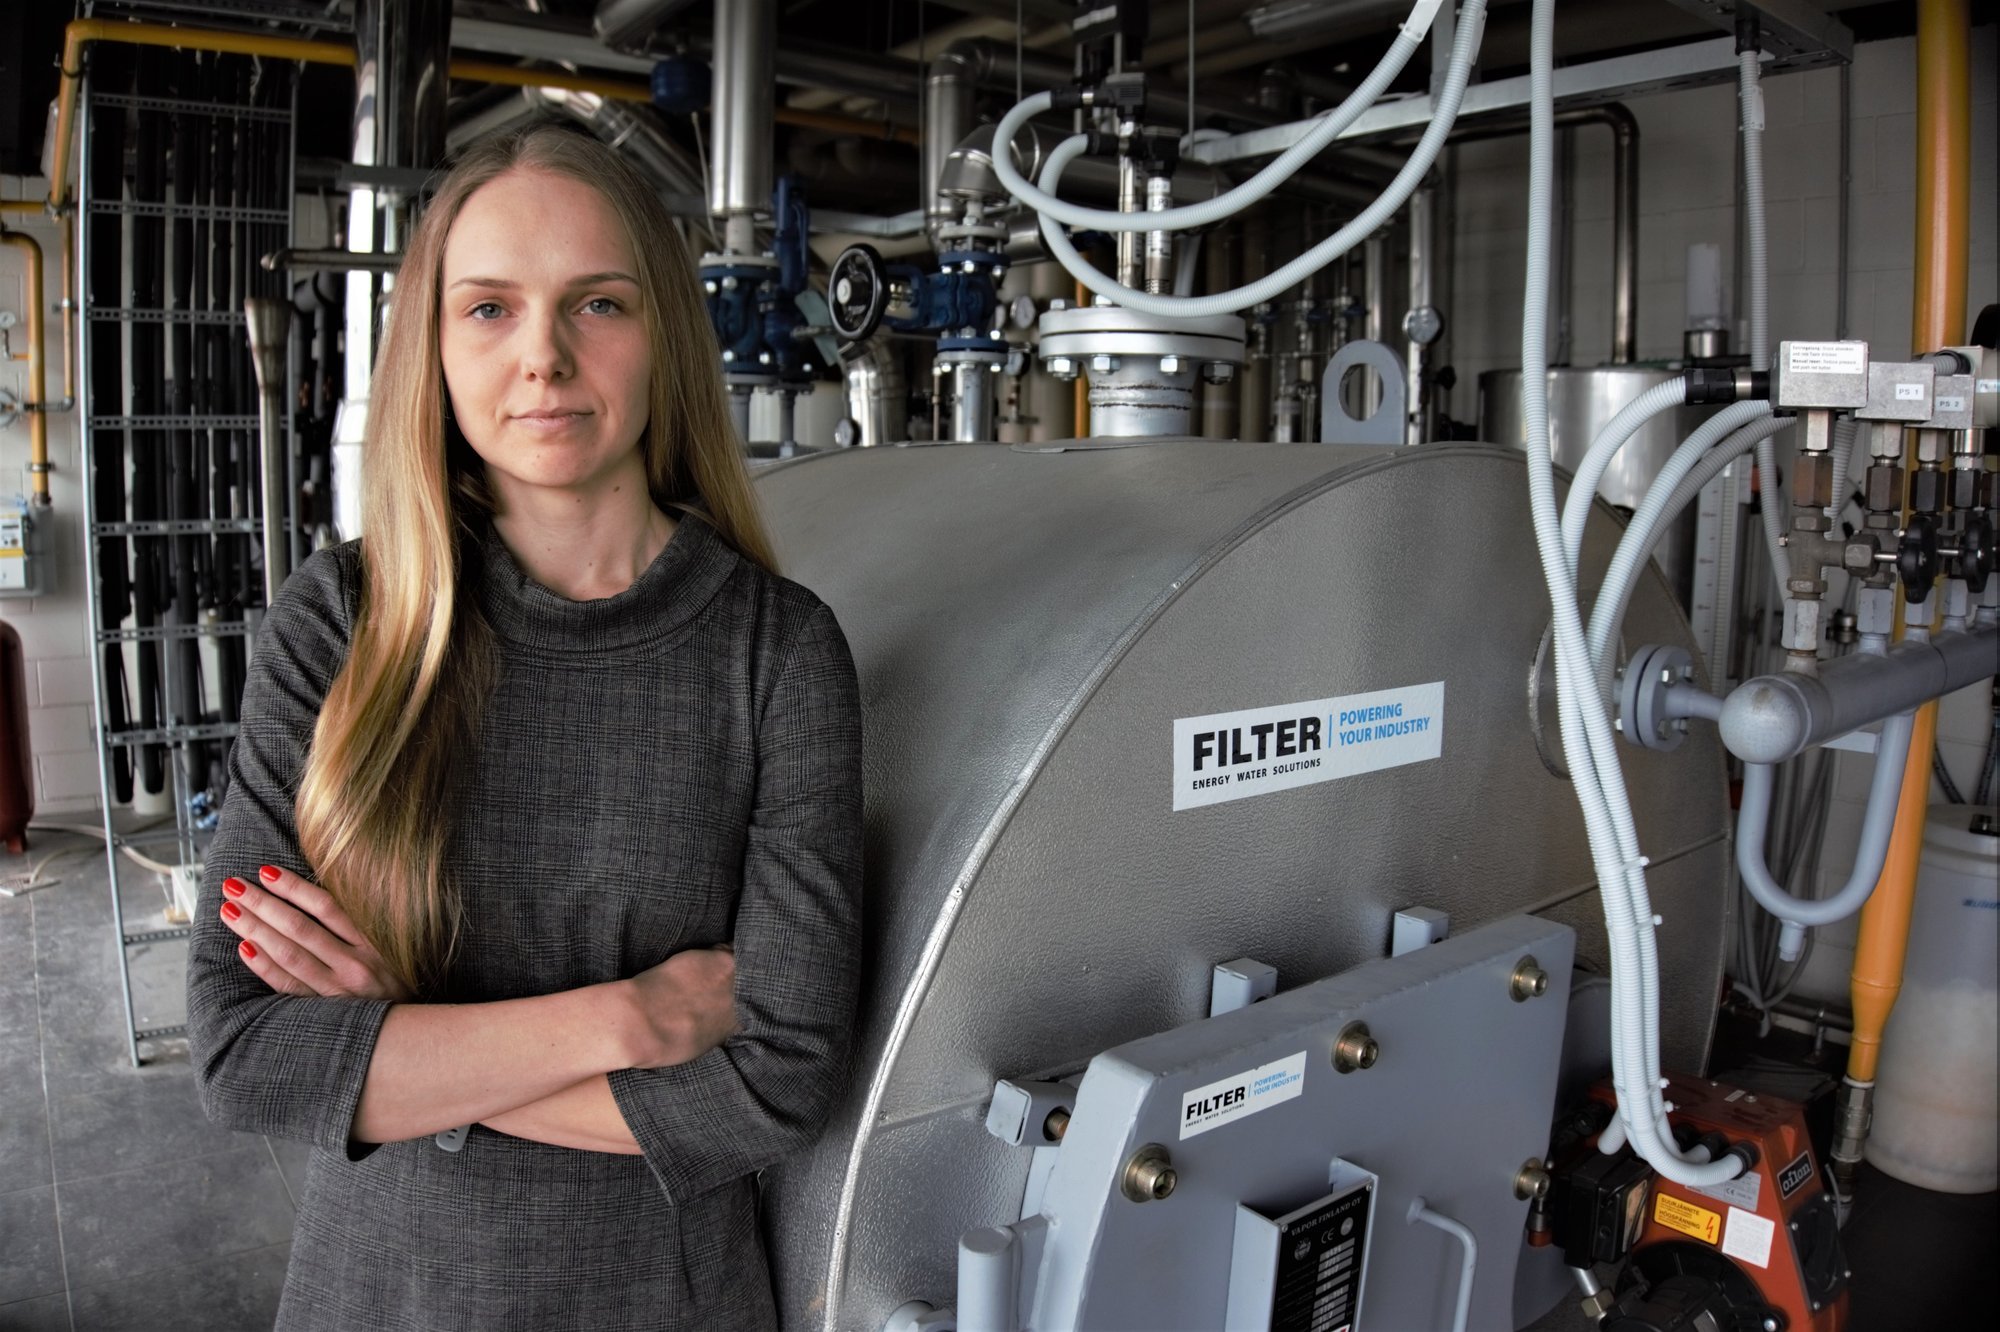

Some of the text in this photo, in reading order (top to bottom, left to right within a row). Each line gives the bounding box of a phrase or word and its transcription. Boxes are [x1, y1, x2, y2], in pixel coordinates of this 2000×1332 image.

[1339, 703, 1402, 726] POWERING
[1193, 716, 1321, 771] FILTER
[1339, 717, 1430, 746] YOUR INDUSTRY
[1192, 758, 1321, 790] ENERGY WATER SOLUTIONS
[1253, 1073, 1301, 1096] YOUR INDUSTRY
[1254, 1071, 1287, 1087] POWERING
[1185, 1103, 1245, 1128] ENERGY WATER SOLUTIONS
[1186, 1086, 1245, 1120] FILTER
[1782, 1163, 1810, 1191] oilon
[1291, 1218, 1318, 1236] VAPOR
[1318, 1201, 1351, 1224] FINLAND
